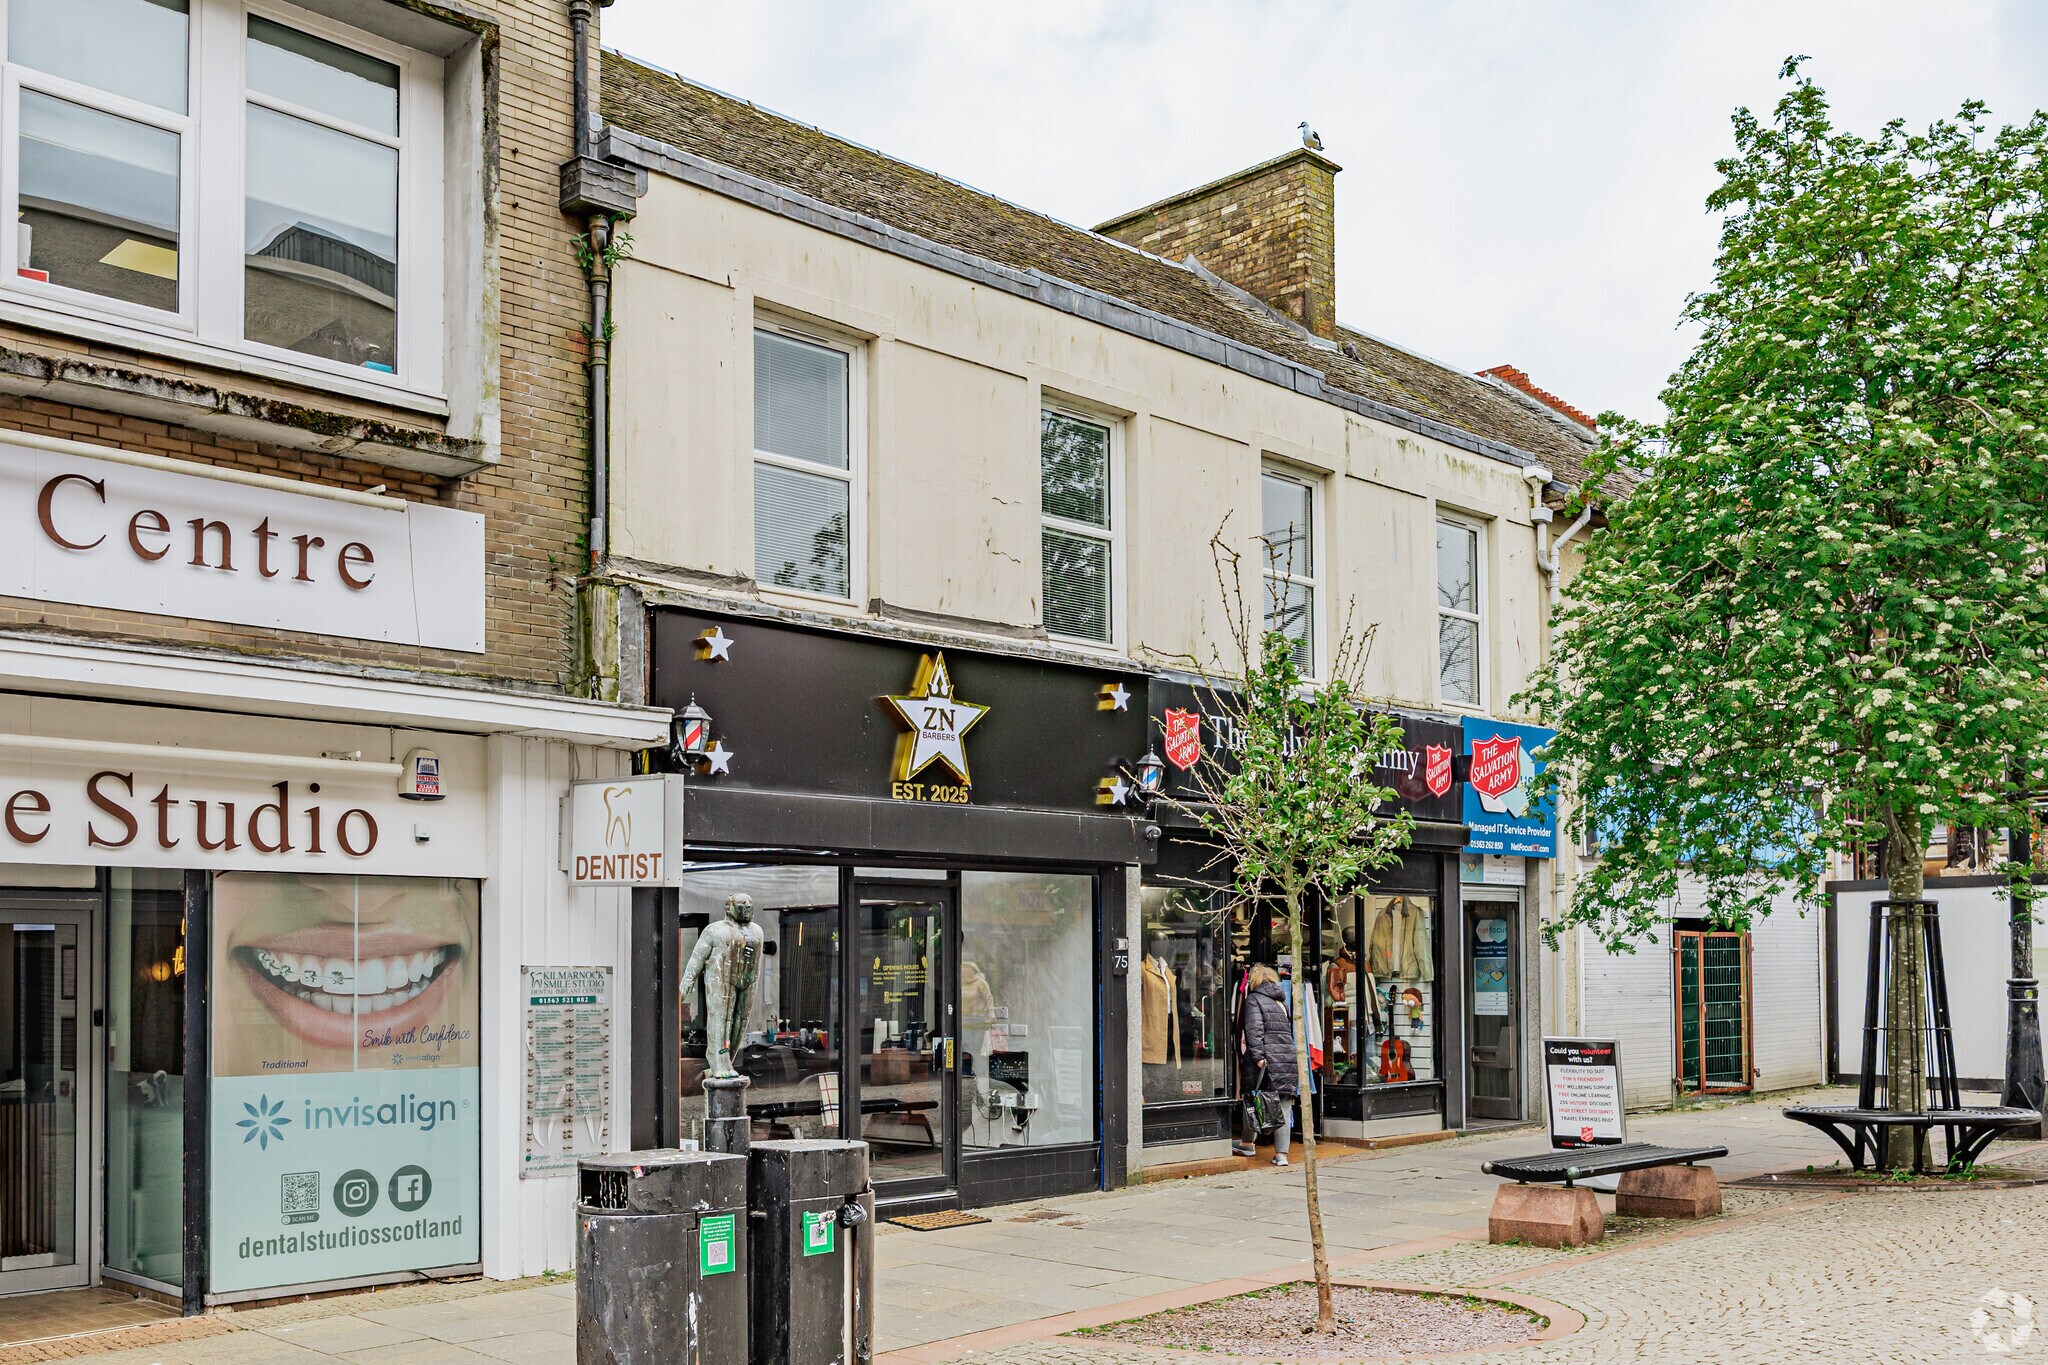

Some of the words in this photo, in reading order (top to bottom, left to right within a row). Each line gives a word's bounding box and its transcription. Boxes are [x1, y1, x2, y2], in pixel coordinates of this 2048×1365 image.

[38, 473, 375, 590] Centre
[923, 707, 956, 732] ZN
[922, 731, 956, 742] BARBERS
[1432, 751, 1441, 765] THE
[1481, 743, 1499, 762] THE
[1427, 755, 1451, 782] SALVATION
[1473, 746, 1516, 783] SALVATION
[1435, 770, 1449, 790] ARMY
[1487, 764, 1514, 791] ARMY
[892, 782, 927, 801] EST.
[930, 784, 969, 803] 2025
[86, 771, 379, 857] Studio
[1468, 821, 1497, 835] Managed
[1497, 823, 1503, 834] IT
[1504, 824, 1526, 836] Service
[1527, 825, 1552, 837] Provider
[1510, 842, 1549, 853] NetFocusICT.com
[575, 852, 662, 881] DENTIST
[1114, 955, 1128, 969] 75
[543, 971, 604, 980] KILMARNOCK
[543, 980, 571, 989] SMILE
[572, 979, 605, 988] STUDIO
[362, 1027, 393, 1048] Smile
[395, 1026, 418, 1045] with
[419, 1023, 471, 1051] Confidence
[1549, 1046, 1567, 1055] Could
[1568, 1048, 1580, 1056] you
[262, 1059, 309, 1069] Traditional
[238, 1215, 463, 1260] dentalstudiosscotland
